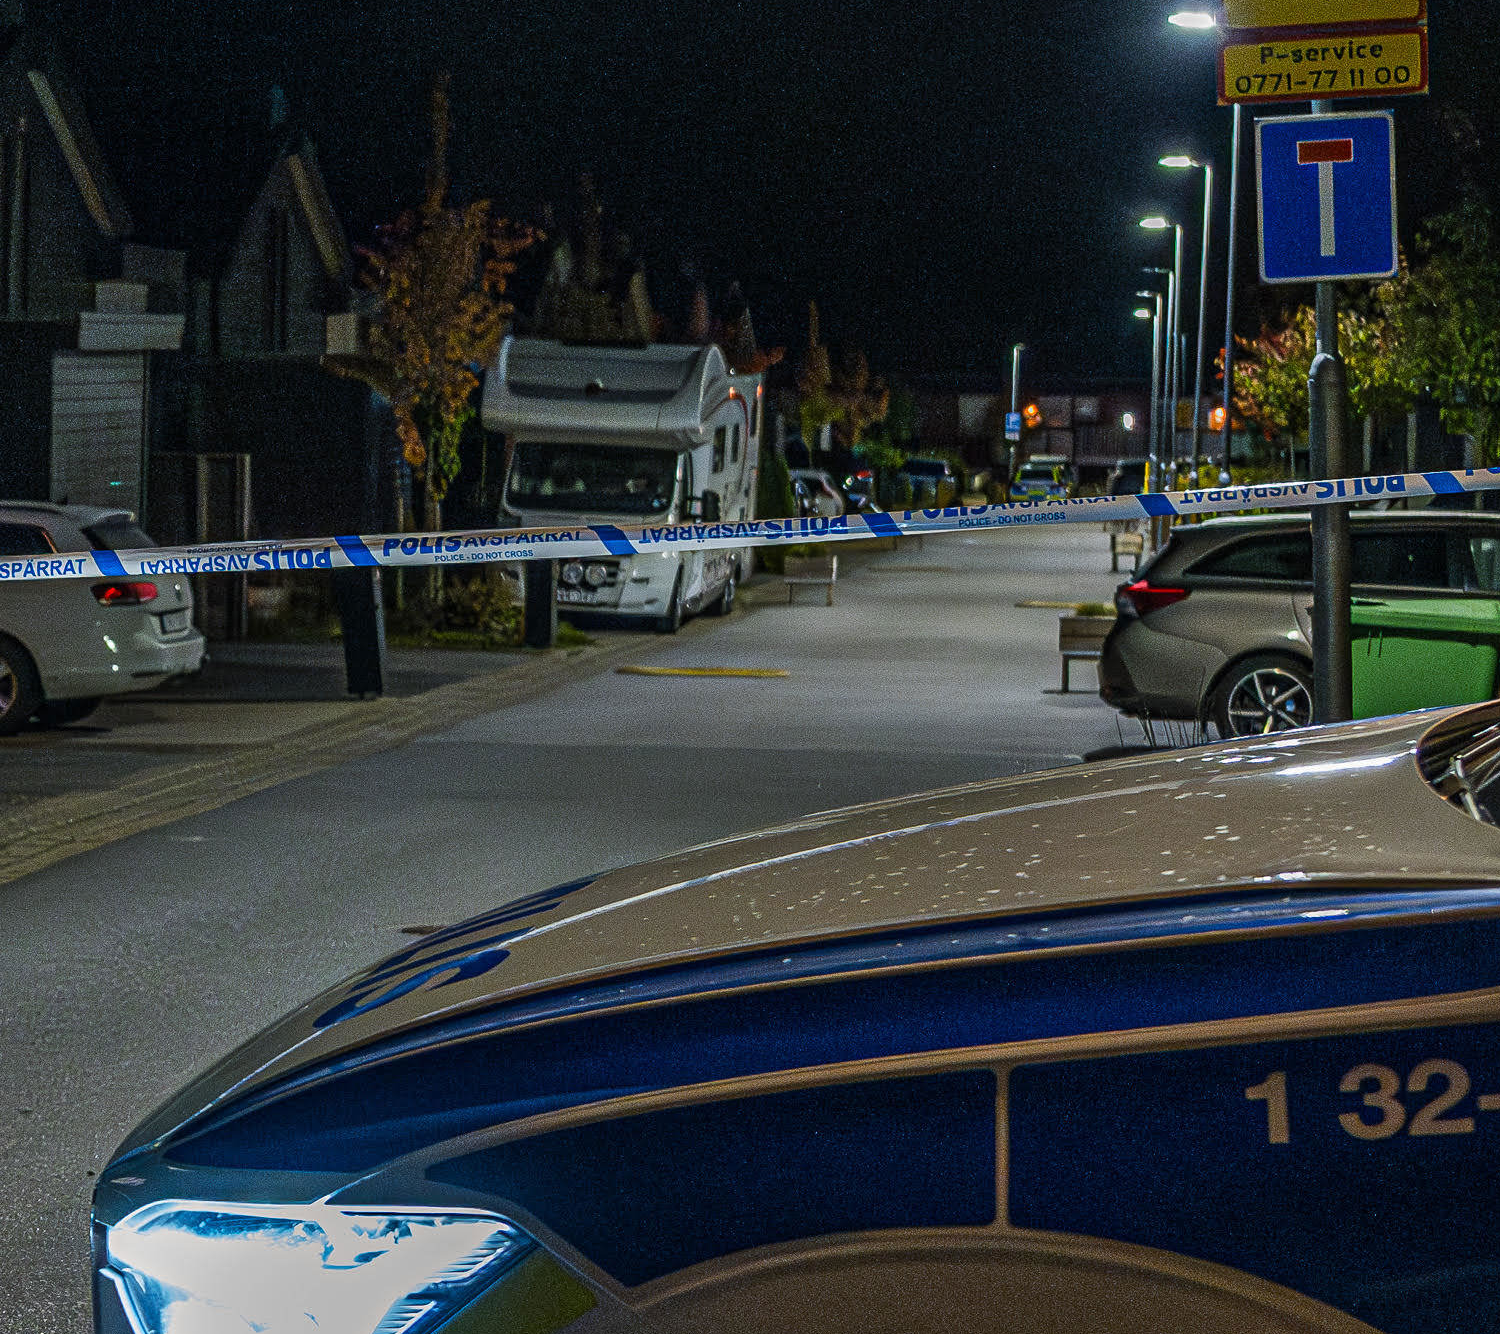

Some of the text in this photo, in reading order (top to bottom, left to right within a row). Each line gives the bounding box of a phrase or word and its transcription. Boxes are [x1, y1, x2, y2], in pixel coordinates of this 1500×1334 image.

[1260, 40, 1384, 64] P-service
[1235, 65, 1410, 94] 0771-77 11 00
[639, 514, 848, 544] POLIS AVSPÄRRAT
[958, 518, 991, 528] POLICE
[998, 515, 1012, 524] DO
[1013, 514, 1033, 523] NOT
[383, 535, 463, 557] POLIS
[434, 553, 465, 563] POLICE
[471, 553, 485, 561] DO
[486, 551, 503, 560] NOT
[505, 549, 534, 558] CROSS
[253, 547, 332, 572] POLIS
[1245, 1070, 1290, 1144] 1
